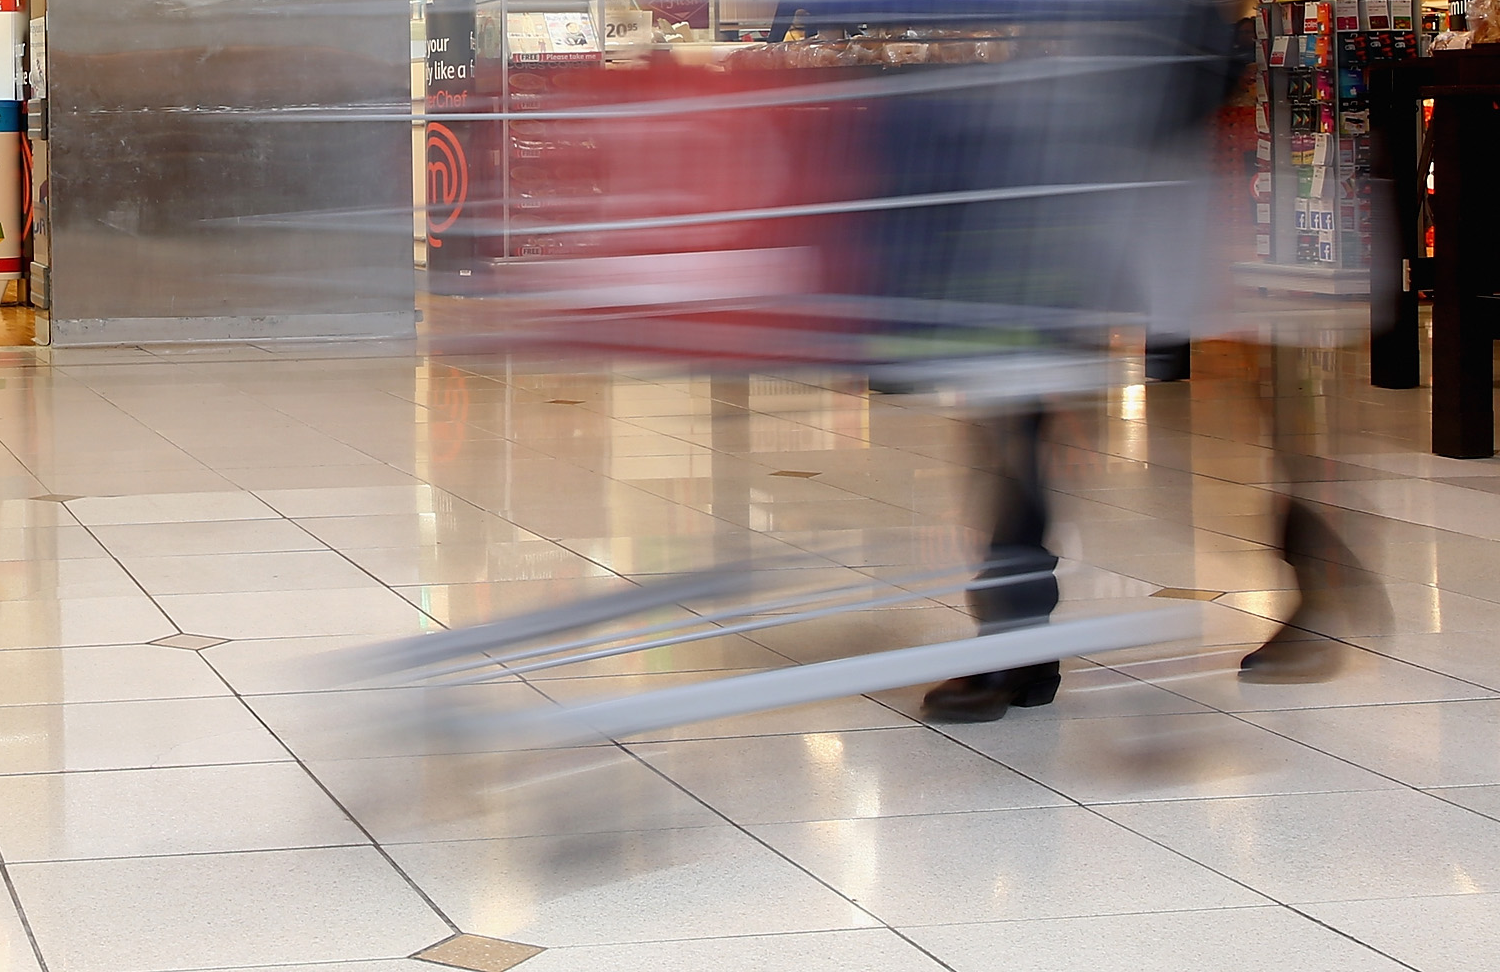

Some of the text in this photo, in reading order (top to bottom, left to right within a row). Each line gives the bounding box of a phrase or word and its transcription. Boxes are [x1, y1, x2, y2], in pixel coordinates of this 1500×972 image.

[426, 37, 449, 59] your
[521, 53, 596, 62] FREE Please take me
[434, 60, 455, 80] like
[457, 65, 466, 79] a
[523, 247, 541, 256] FREE
